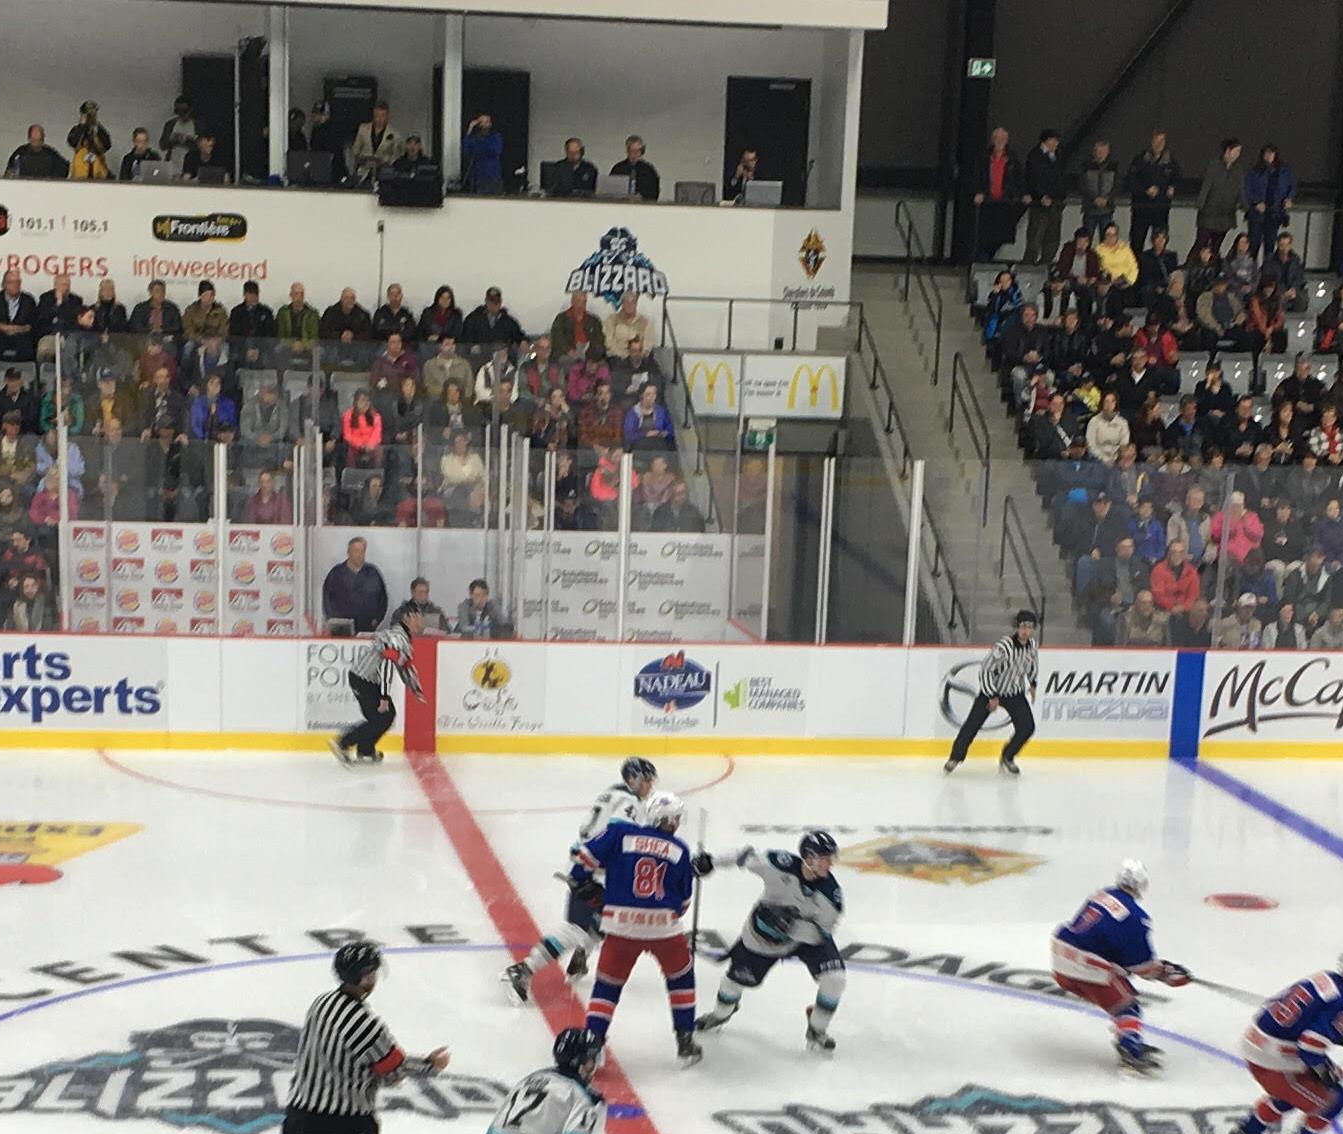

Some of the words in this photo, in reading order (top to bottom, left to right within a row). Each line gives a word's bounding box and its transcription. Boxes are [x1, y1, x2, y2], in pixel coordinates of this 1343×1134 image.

[18, 217, 55, 231] 101.1
[72, 219, 108, 232] 105.1
[133, 254, 268, 280] infoweekend
[565, 267, 667, 293] BLIZZARD
[638, 671, 707, 694] NADEAU
[1044, 670, 1170, 695] MARTIN
[1041, 699, 1169, 721] mazda
[632, 856, 668, 901] 81
